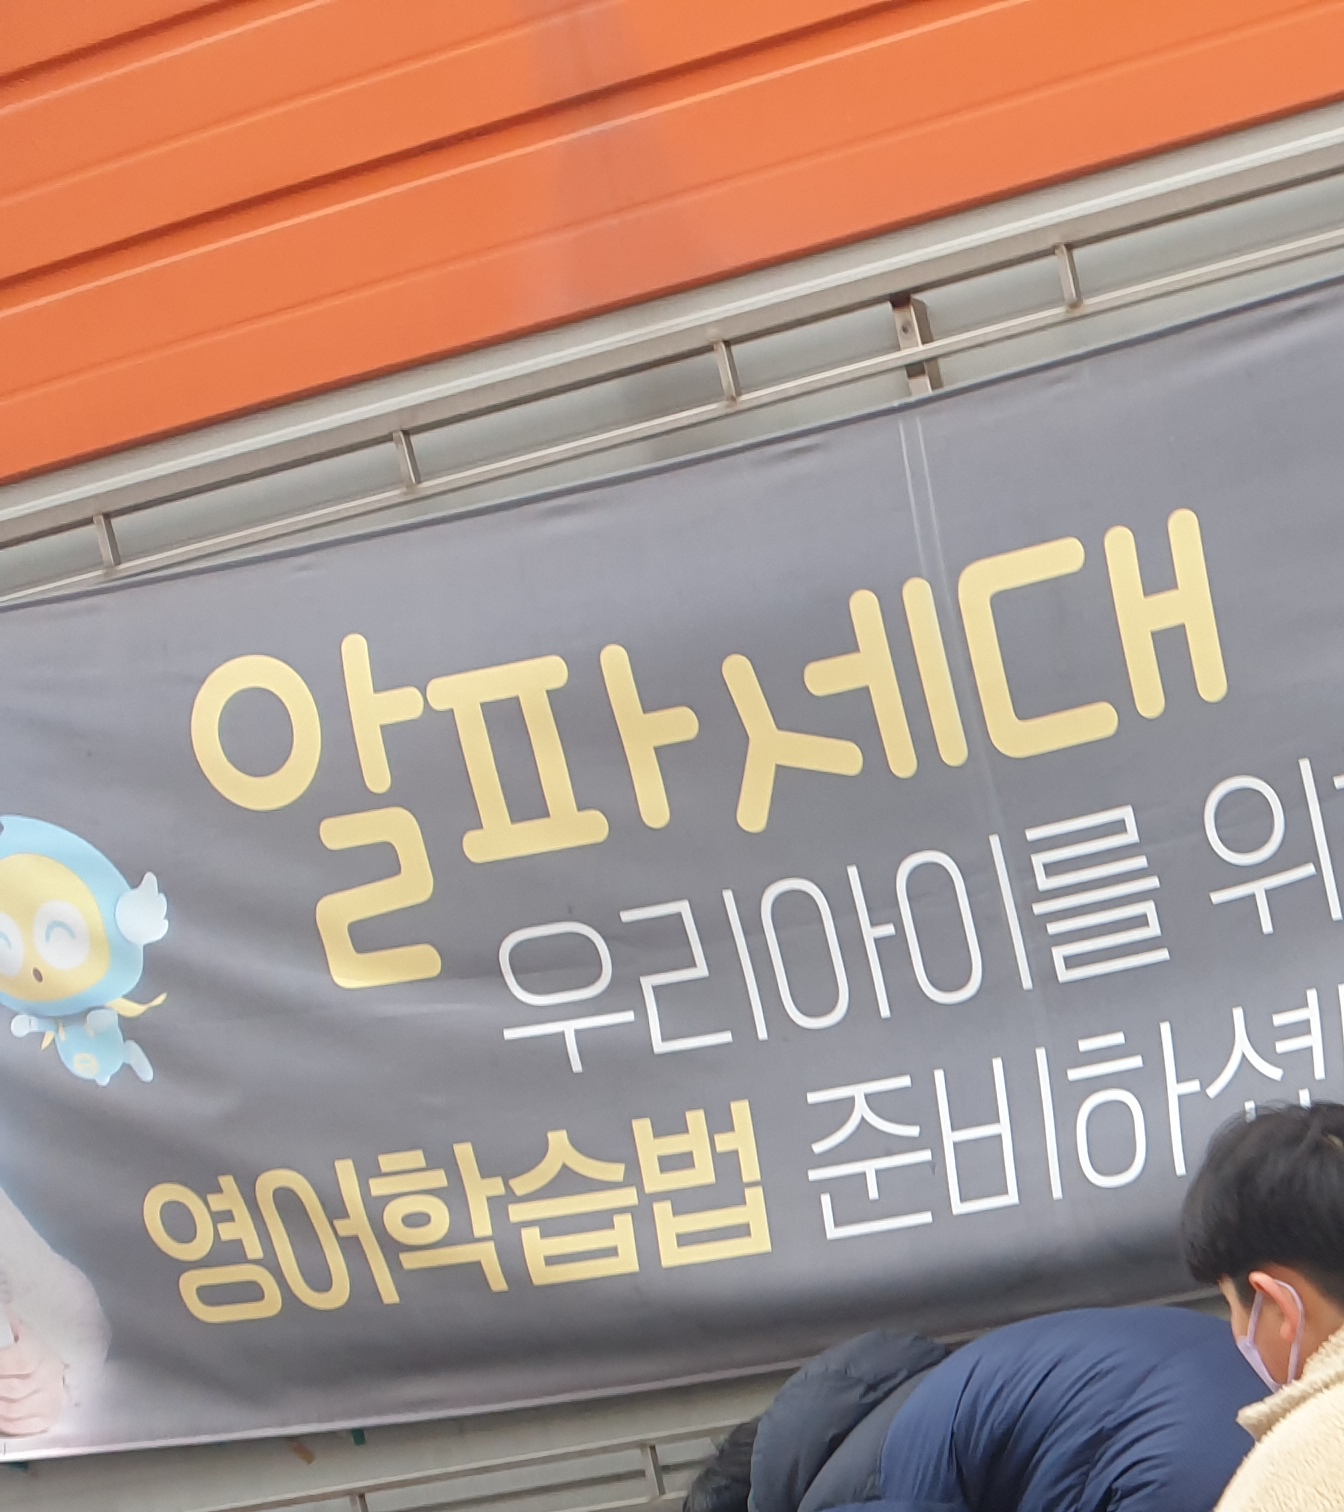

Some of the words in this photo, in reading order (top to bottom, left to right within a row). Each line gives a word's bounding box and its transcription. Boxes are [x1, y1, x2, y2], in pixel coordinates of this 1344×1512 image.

[190, 508, 1229, 990] 알파세대
[498, 804, 1171, 1074] 우리아이를
[141, 1098, 773, 1325] 영어학습법
